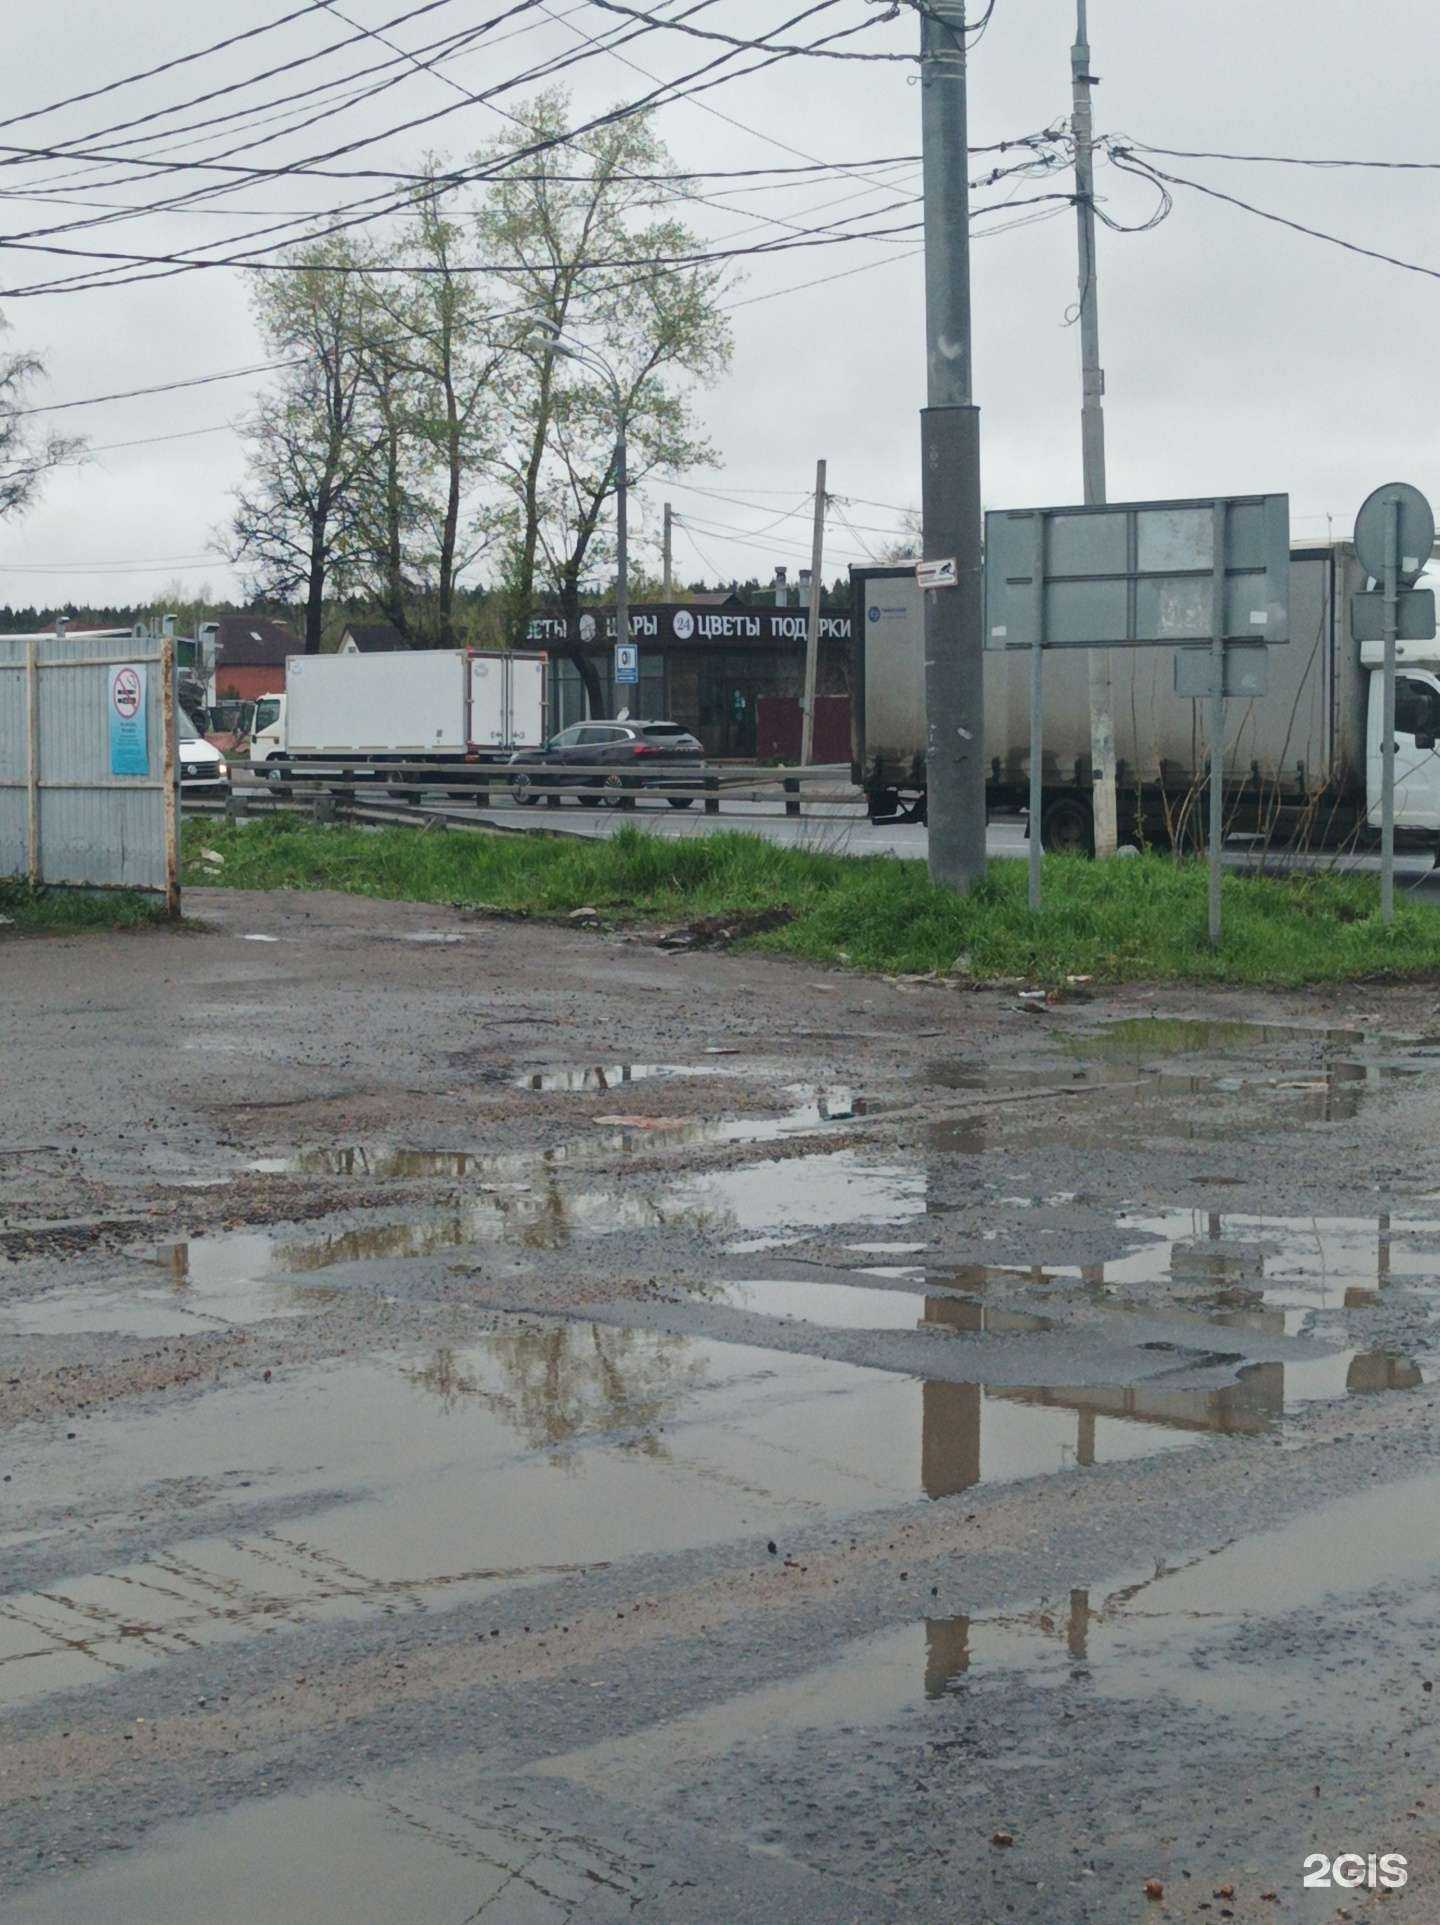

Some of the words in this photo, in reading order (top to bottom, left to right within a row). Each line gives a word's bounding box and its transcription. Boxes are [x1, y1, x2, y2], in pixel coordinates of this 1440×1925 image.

[677, 617, 691, 631] 24
[697, 615, 761, 640] ЦВЕТЫ
[771, 617, 852, 641] ПОДРКИ
